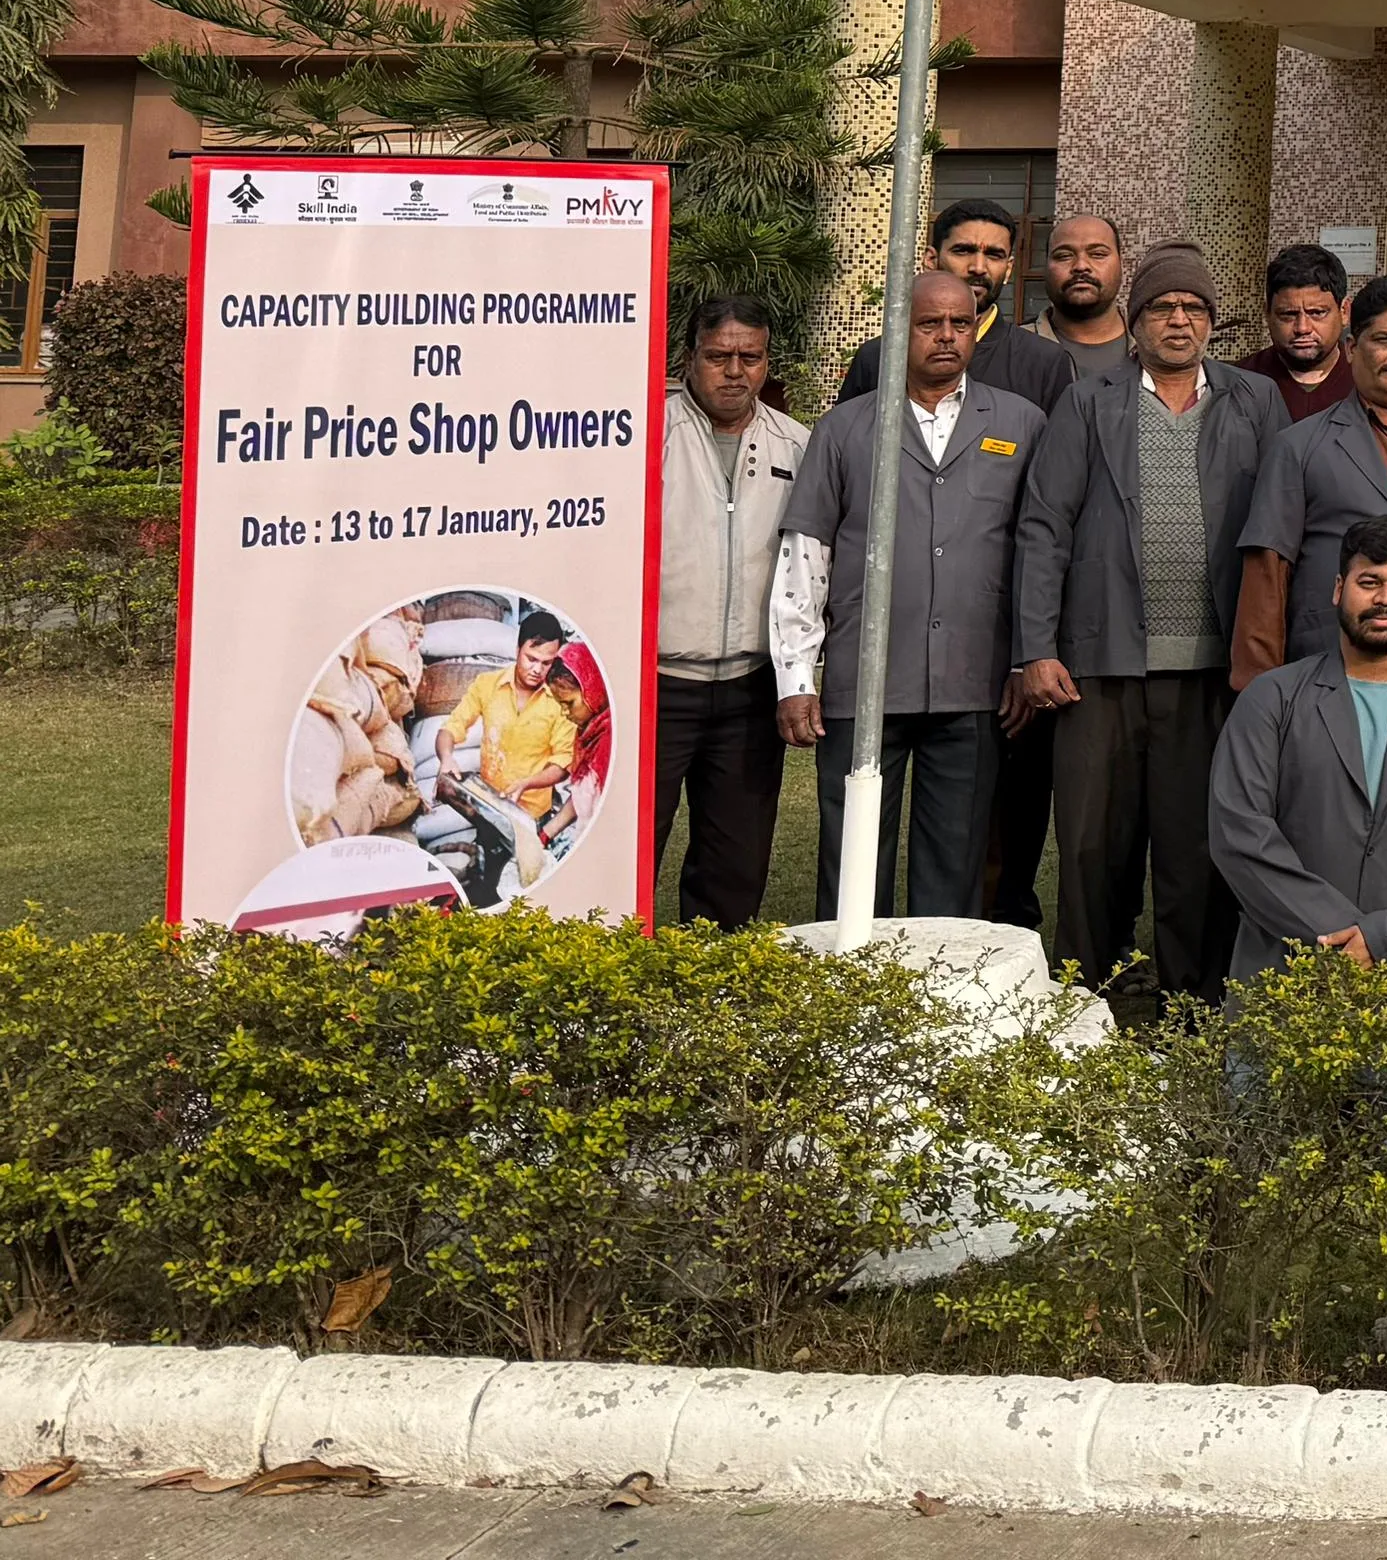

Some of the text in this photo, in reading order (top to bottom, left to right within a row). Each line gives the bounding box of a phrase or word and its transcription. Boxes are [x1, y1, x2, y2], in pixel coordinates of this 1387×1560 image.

[298, 202, 357, 214] Skill India
[566, 186, 644, 217] PMKVY
[221, 292, 637, 328] CAPACITY BUILDING PROGRAMME
[413, 345, 462, 377] FOR
[216, 399, 633, 465] Fair Price Shop Owners
[241, 515, 306, 549] Date
[331, 510, 361, 542] 13
[369, 512, 393, 540] to
[402, 506, 432, 538] 17
[437, 504, 539, 537] January,
[546, 496, 606, 529] 2025
